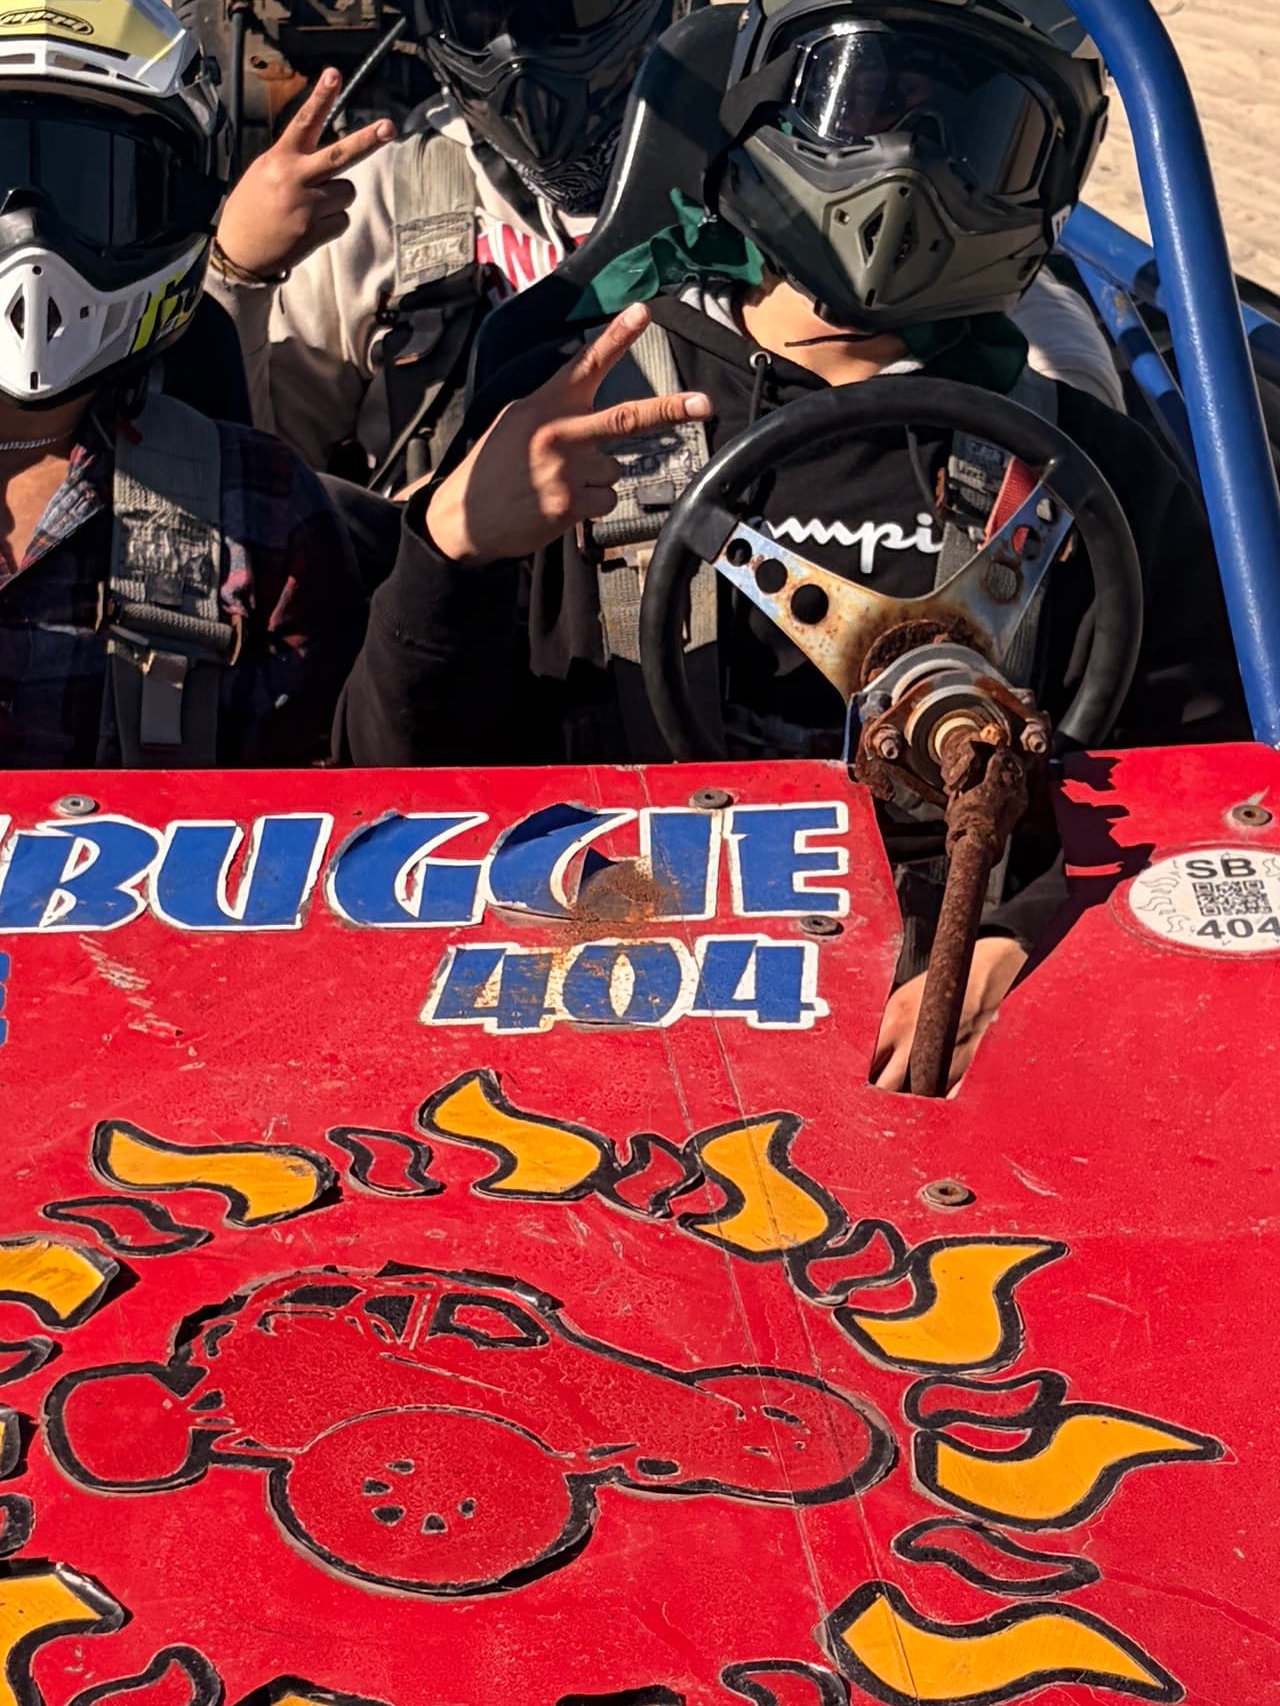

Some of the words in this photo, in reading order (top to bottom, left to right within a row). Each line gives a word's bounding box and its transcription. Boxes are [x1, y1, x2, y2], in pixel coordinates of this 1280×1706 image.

[764, 512, 944, 575] mpi
[1185, 858, 1257, 879] SB
[420, 938, 830, 1034] 404
